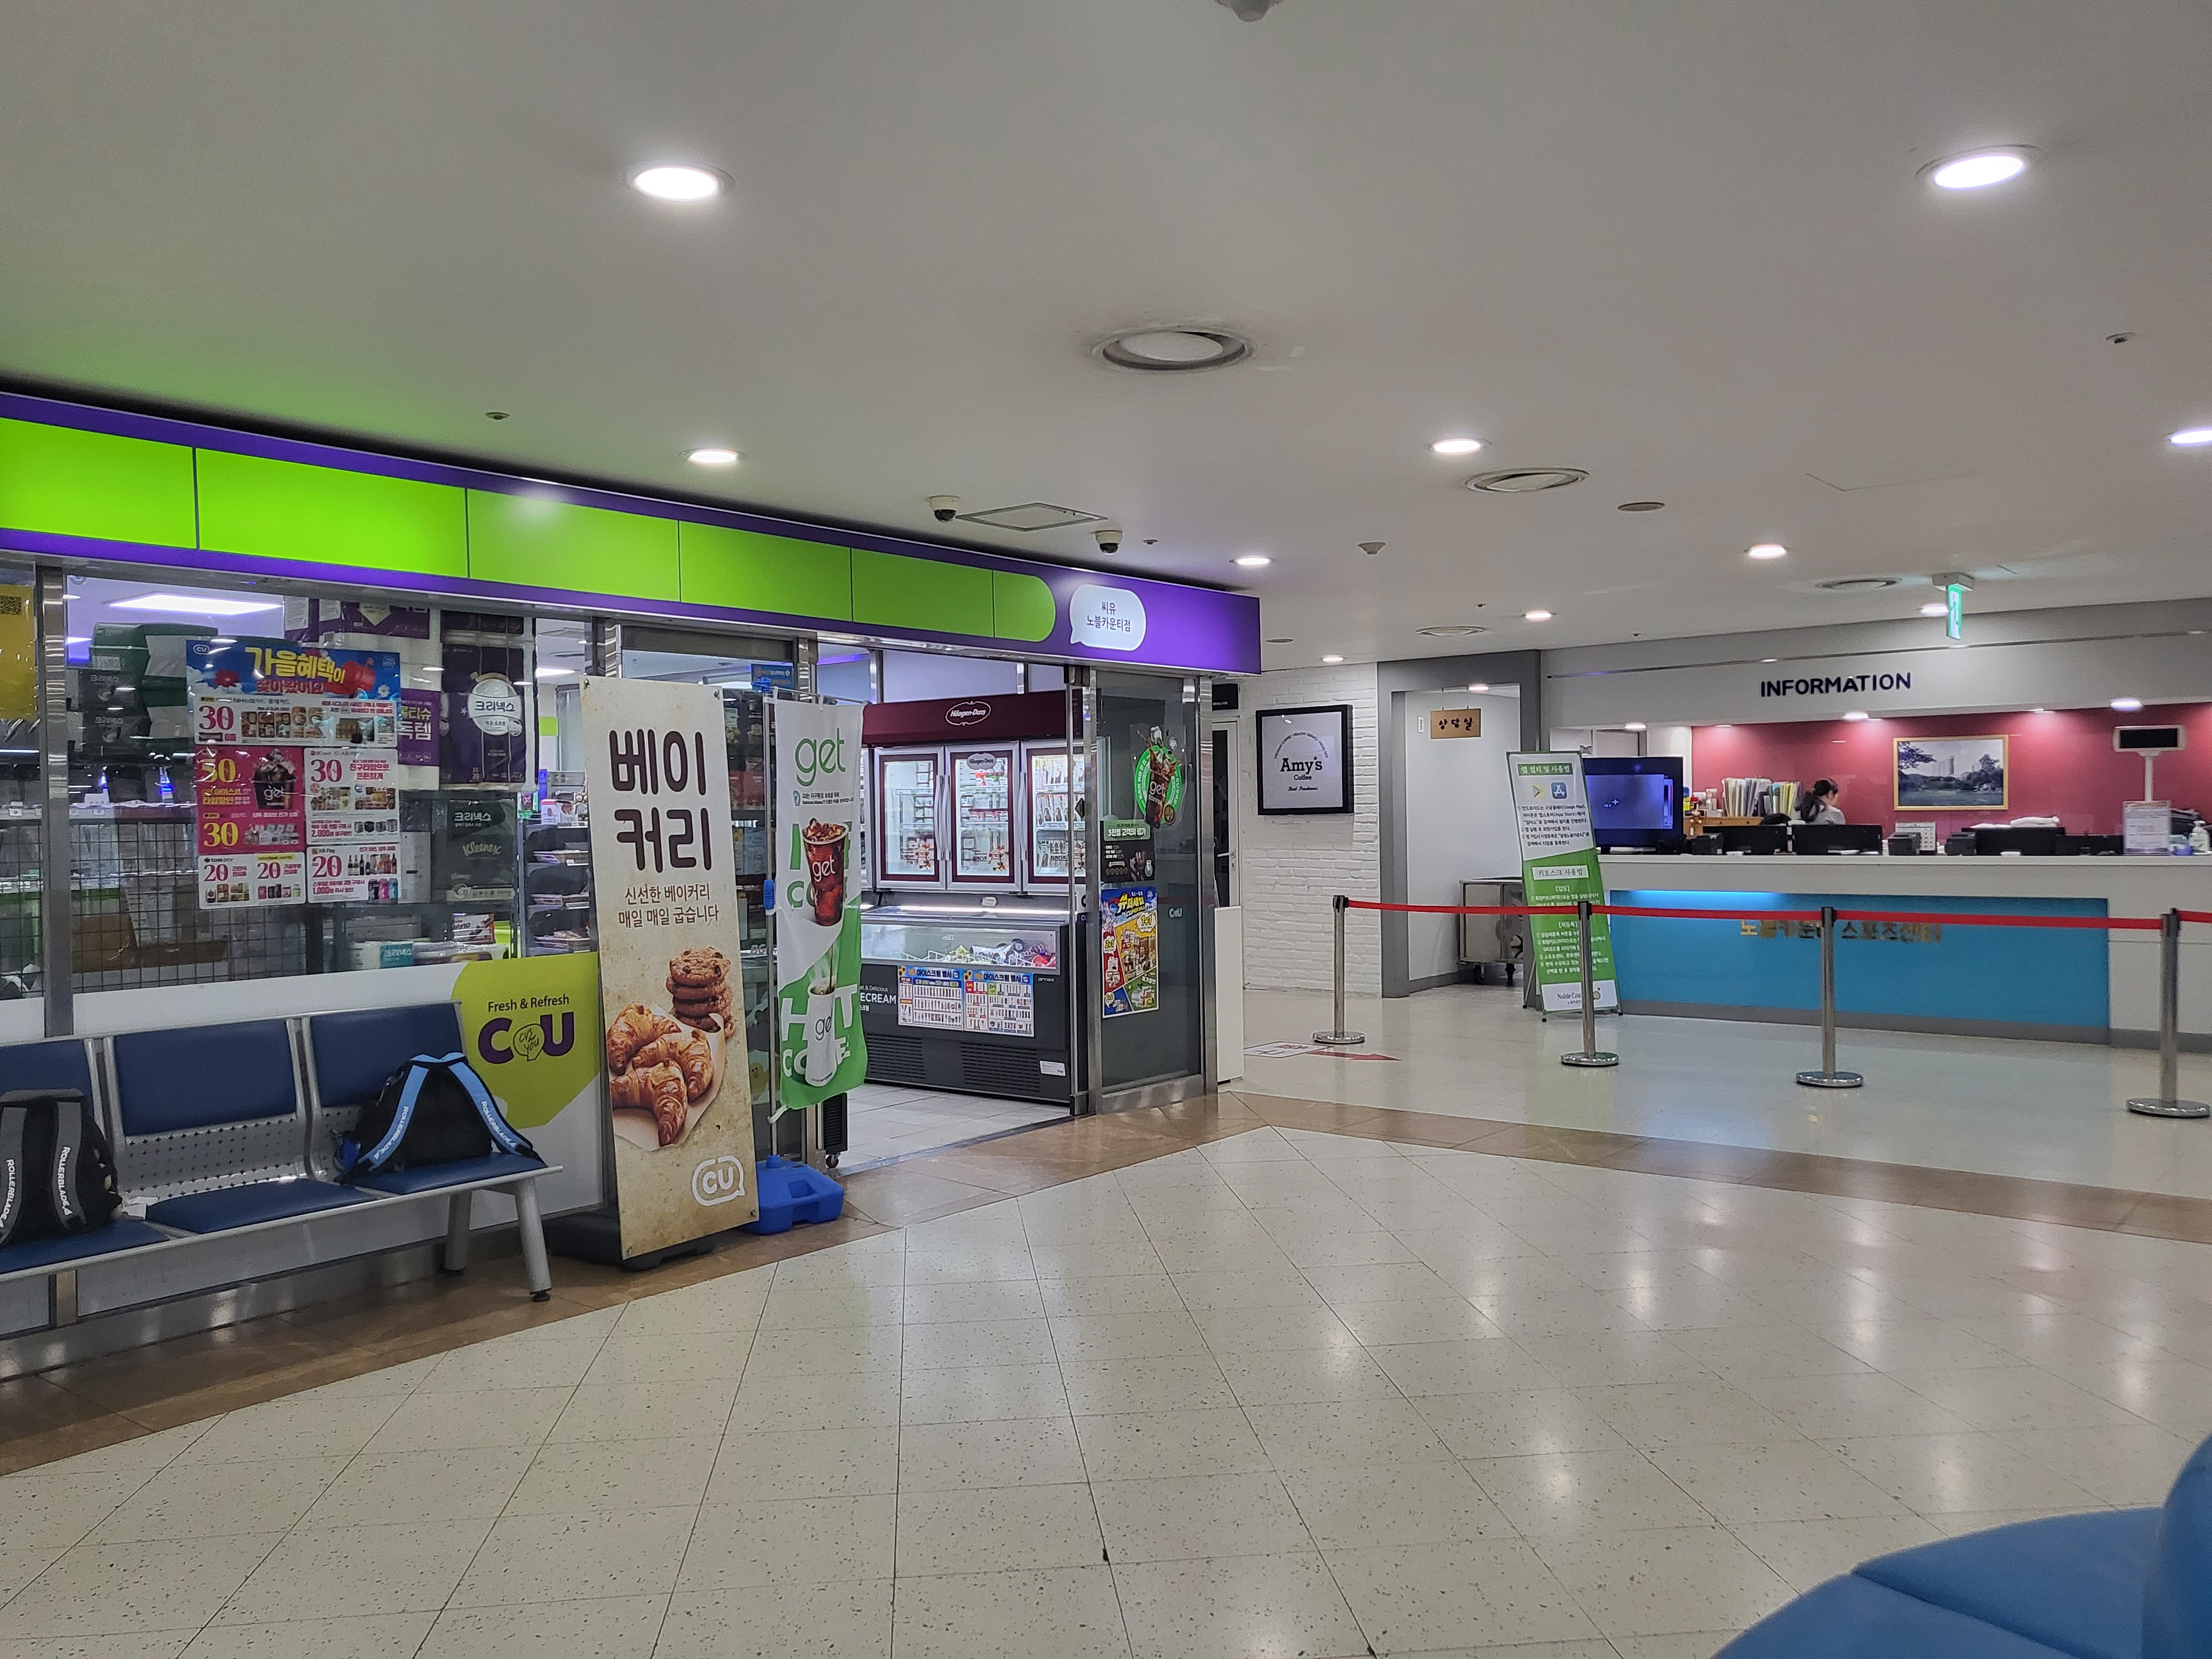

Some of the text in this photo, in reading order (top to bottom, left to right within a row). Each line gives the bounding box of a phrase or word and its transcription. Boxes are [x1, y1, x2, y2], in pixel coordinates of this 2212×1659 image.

[1101, 601, 1116, 615] 씨유
[1086, 614, 1131, 632] 노블카운티점
[245, 646, 346, 684] 가을혜택이
[257, 679, 324, 694] 찾아왔어요
[1761, 671, 1911, 697] INFORMATION
[474, 701, 516, 712] 크리넥스
[1438, 717, 1473, 731] 상담실
[1281, 734, 1292, 745] COFFEE
[609, 728, 706, 796] 베이
[795, 727, 846, 787] get
[1280, 756, 1323, 775] Amy's
[1521, 765, 1571, 774] 앱 설치 및 사용법
[1149, 781, 1166, 797] get
[453, 812, 492, 822] 크리넥스
[614, 806, 712, 873] 커리
[1108, 827, 1146, 837] 3천명 고객의 평가
[462, 841, 502, 857] Kleenex
[812, 854, 836, 882] get
[1564, 868, 1583, 876] 사용법
[625, 883, 710, 905] 신선한 베이커리
[618, 904, 719, 928] 매일 매일 굽습니다
[1141, 914, 1152, 926] 1+1
[1105, 940, 1115, 949] 2+1
[383, 948, 413, 957] 크리넥스
[916, 969, 941, 978] 아이스크림
[983, 973, 1010, 982] 아이스크림
[488, 993, 570, 1013] Fresh & Refresh
[860, 992, 896, 1005] ECREAM
[1557, 992, 1572, 1000] Noble
[478, 1011, 575, 1065] CU
[702, 1166, 734, 1194] CU
